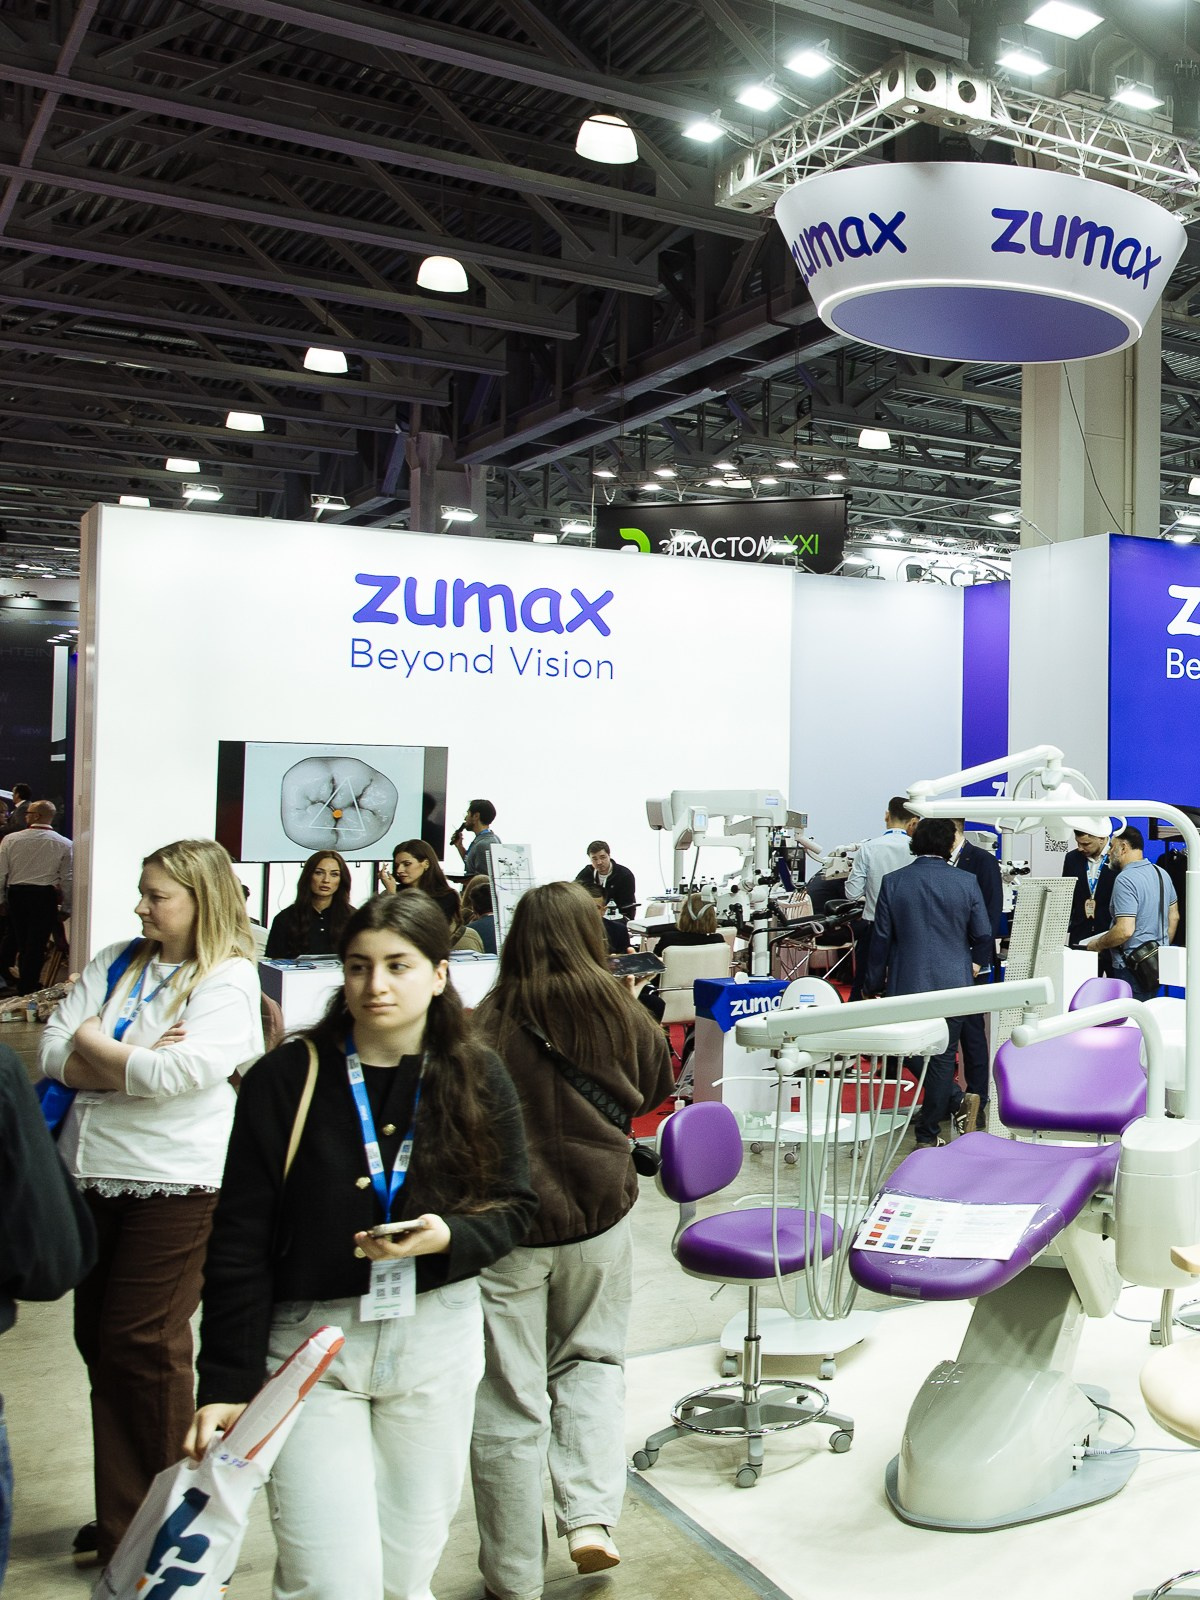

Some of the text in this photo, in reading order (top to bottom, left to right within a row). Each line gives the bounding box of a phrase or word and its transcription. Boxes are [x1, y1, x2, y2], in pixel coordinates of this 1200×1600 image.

[991, 207, 1162, 290] zumax
[352, 573, 614, 637] zumax
[351, 637, 614, 680] Beyond Vision
[730, 989, 786, 1017] zuma
